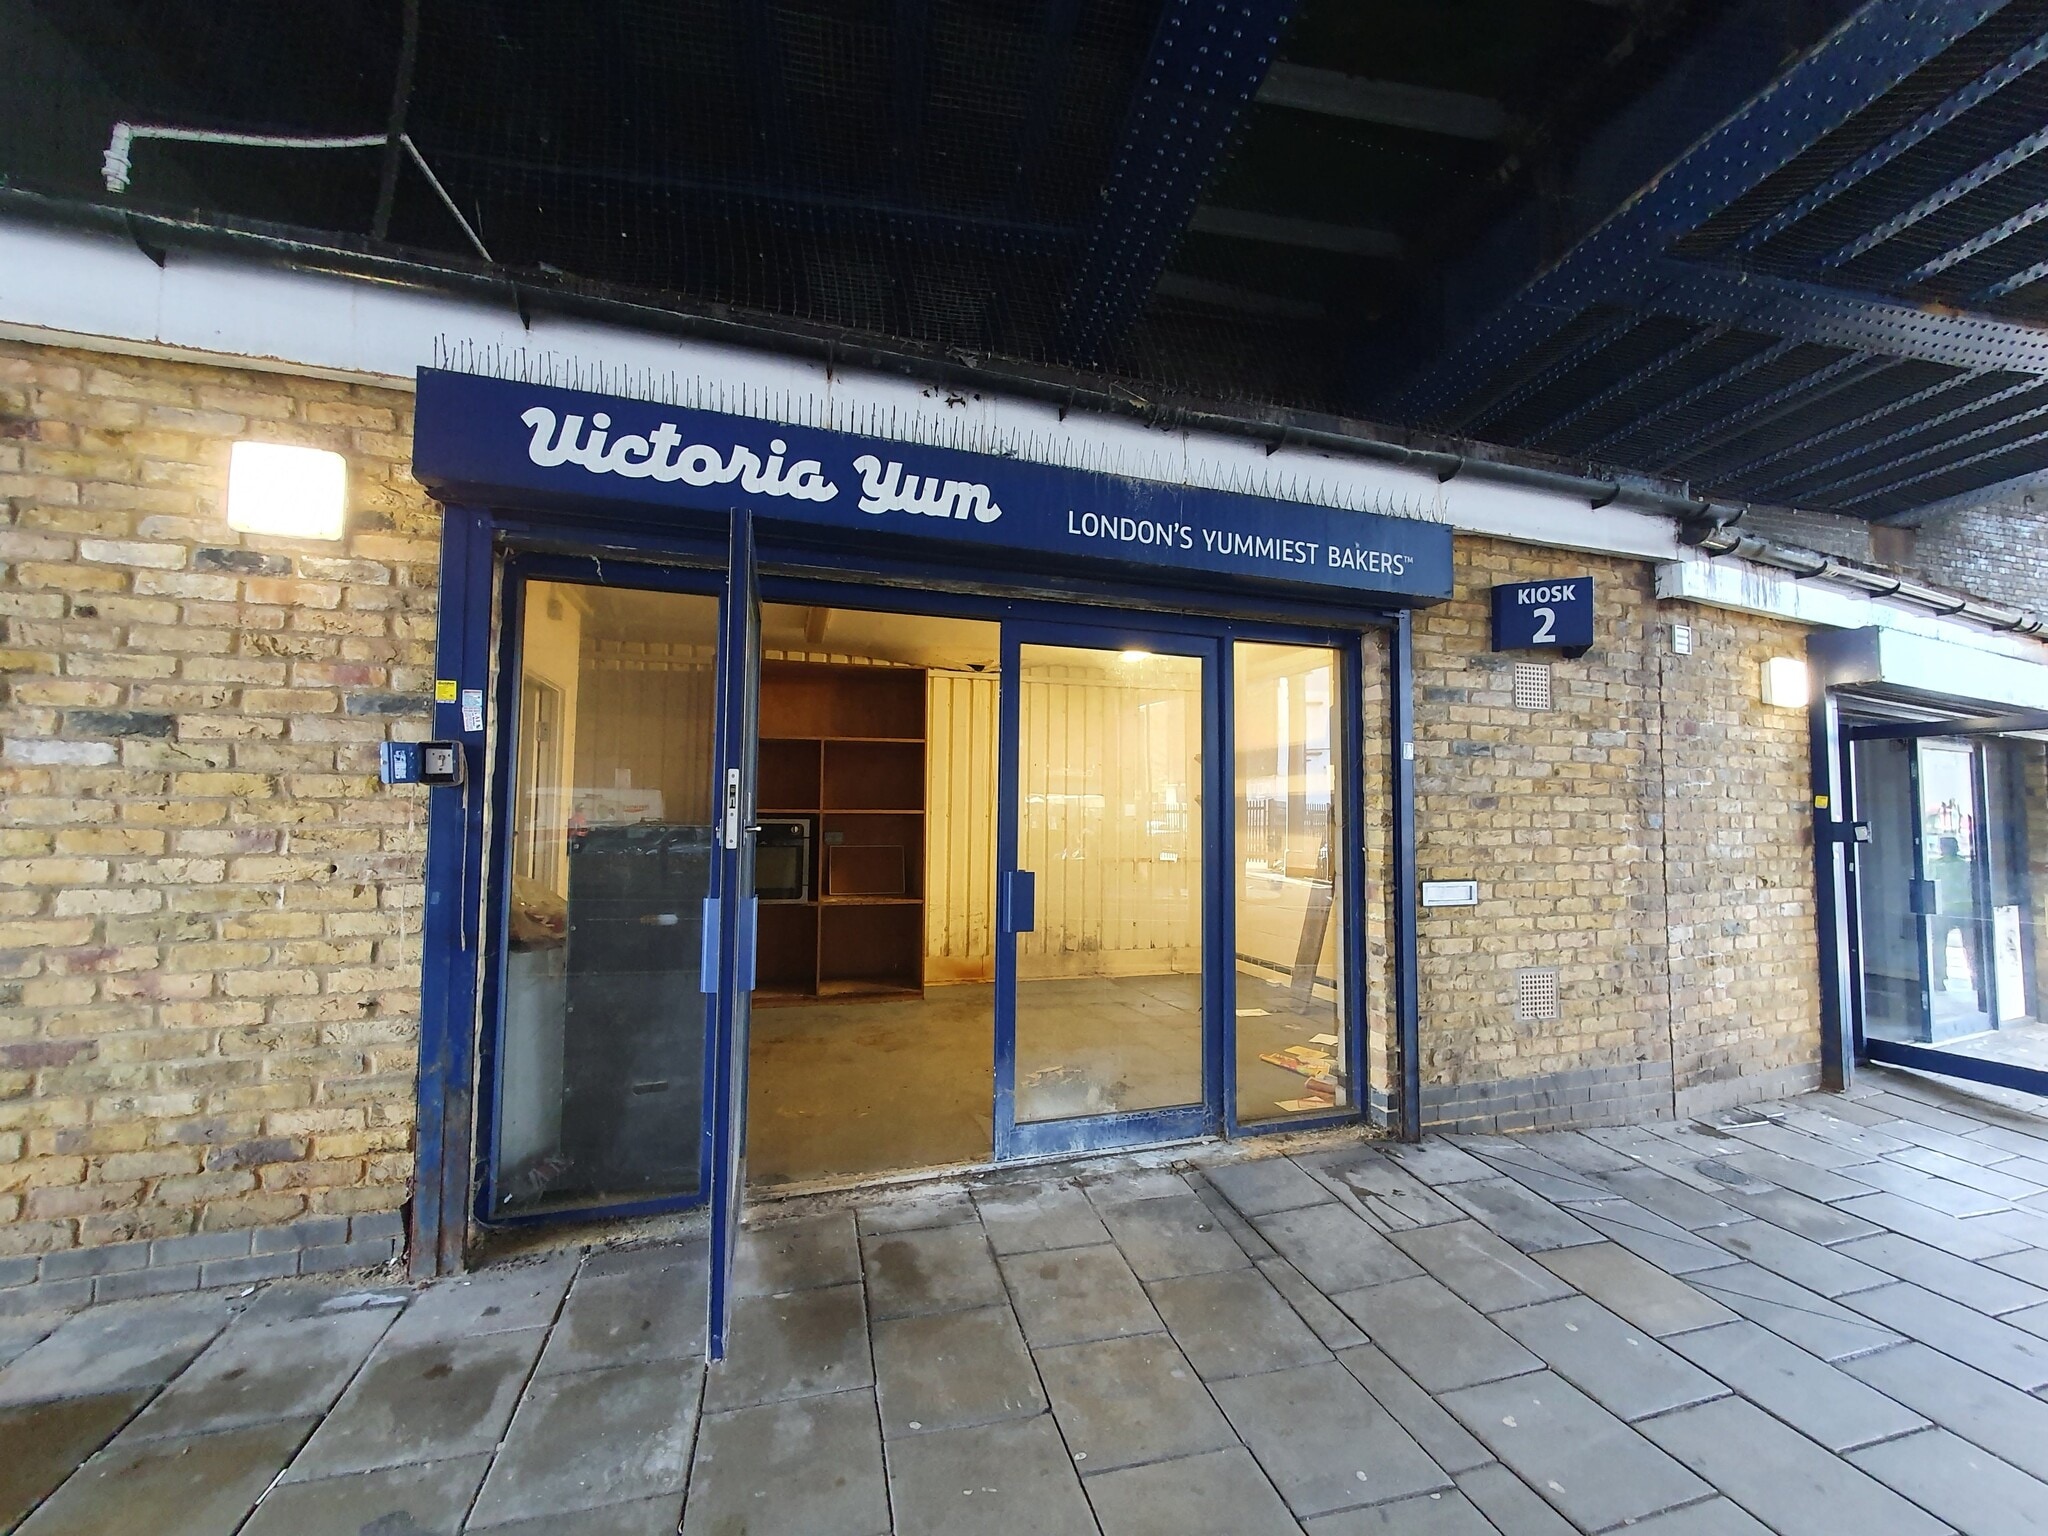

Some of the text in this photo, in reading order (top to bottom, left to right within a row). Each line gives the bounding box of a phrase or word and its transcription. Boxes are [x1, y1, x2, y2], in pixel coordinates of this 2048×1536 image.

[520, 405, 1003, 523] Victoria Yum
[1067, 510, 1194, 549] LONDON'S
[1202, 529, 1319, 565] YUMMIEST
[1517, 584, 1576, 605] KIOSK
[1532, 607, 1556, 644] 2
